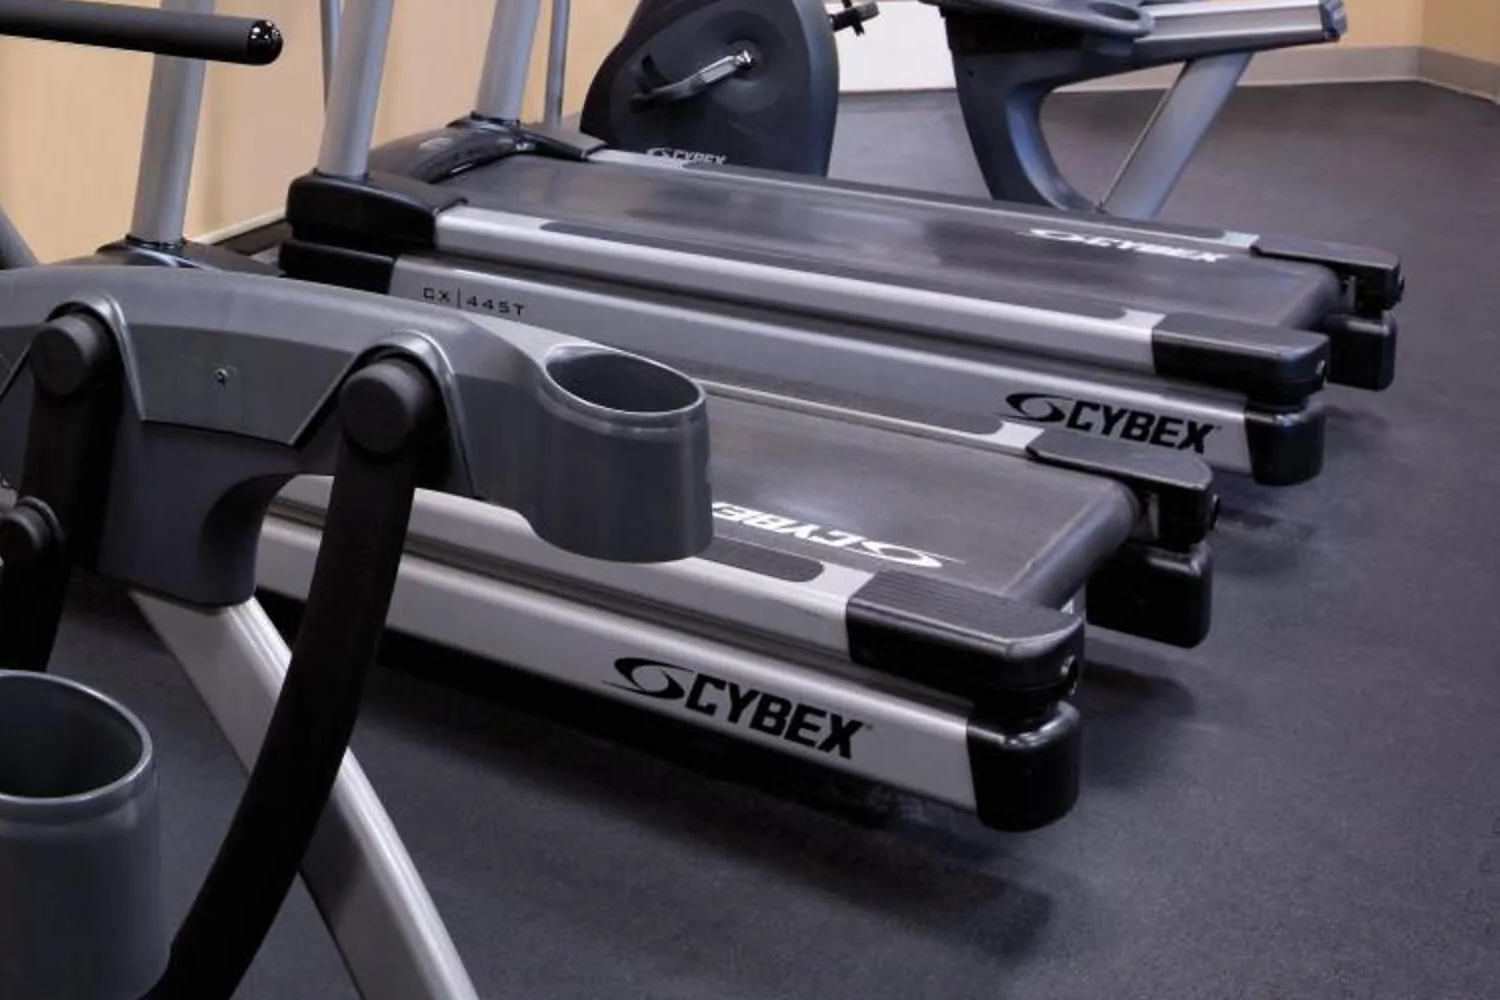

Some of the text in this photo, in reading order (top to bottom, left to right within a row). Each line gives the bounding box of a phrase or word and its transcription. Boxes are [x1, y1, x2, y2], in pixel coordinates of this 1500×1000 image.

[1066, 400, 1216, 454] CYBEX
[711, 501, 866, 549] CYBE
[684, 673, 865, 760] CYBEX
